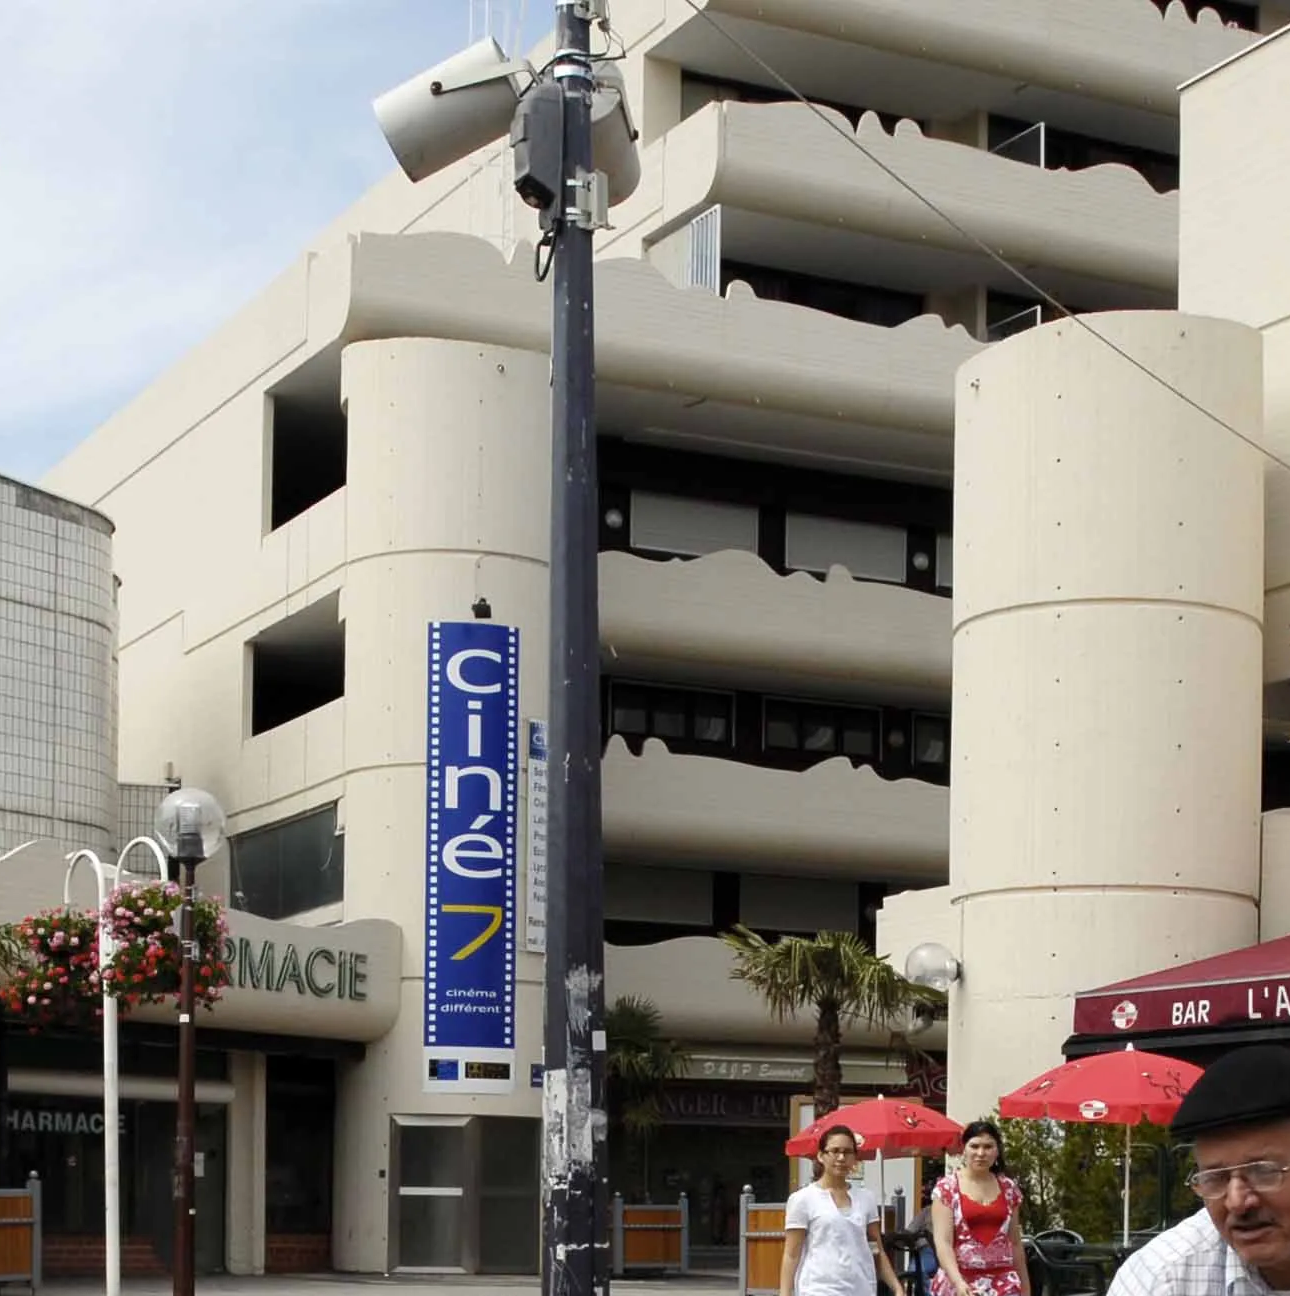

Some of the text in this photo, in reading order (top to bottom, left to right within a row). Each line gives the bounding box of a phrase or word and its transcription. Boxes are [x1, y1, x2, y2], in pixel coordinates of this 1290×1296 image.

[441, 648, 504, 961] ciné 7
[220, 936, 369, 1001] RMACIE
[445, 988, 497, 998] cinéma
[440, 1003, 502, 1013] différent
[1171, 999, 1211, 1026] BAR
[6, 1109, 127, 1135] HARMACE
